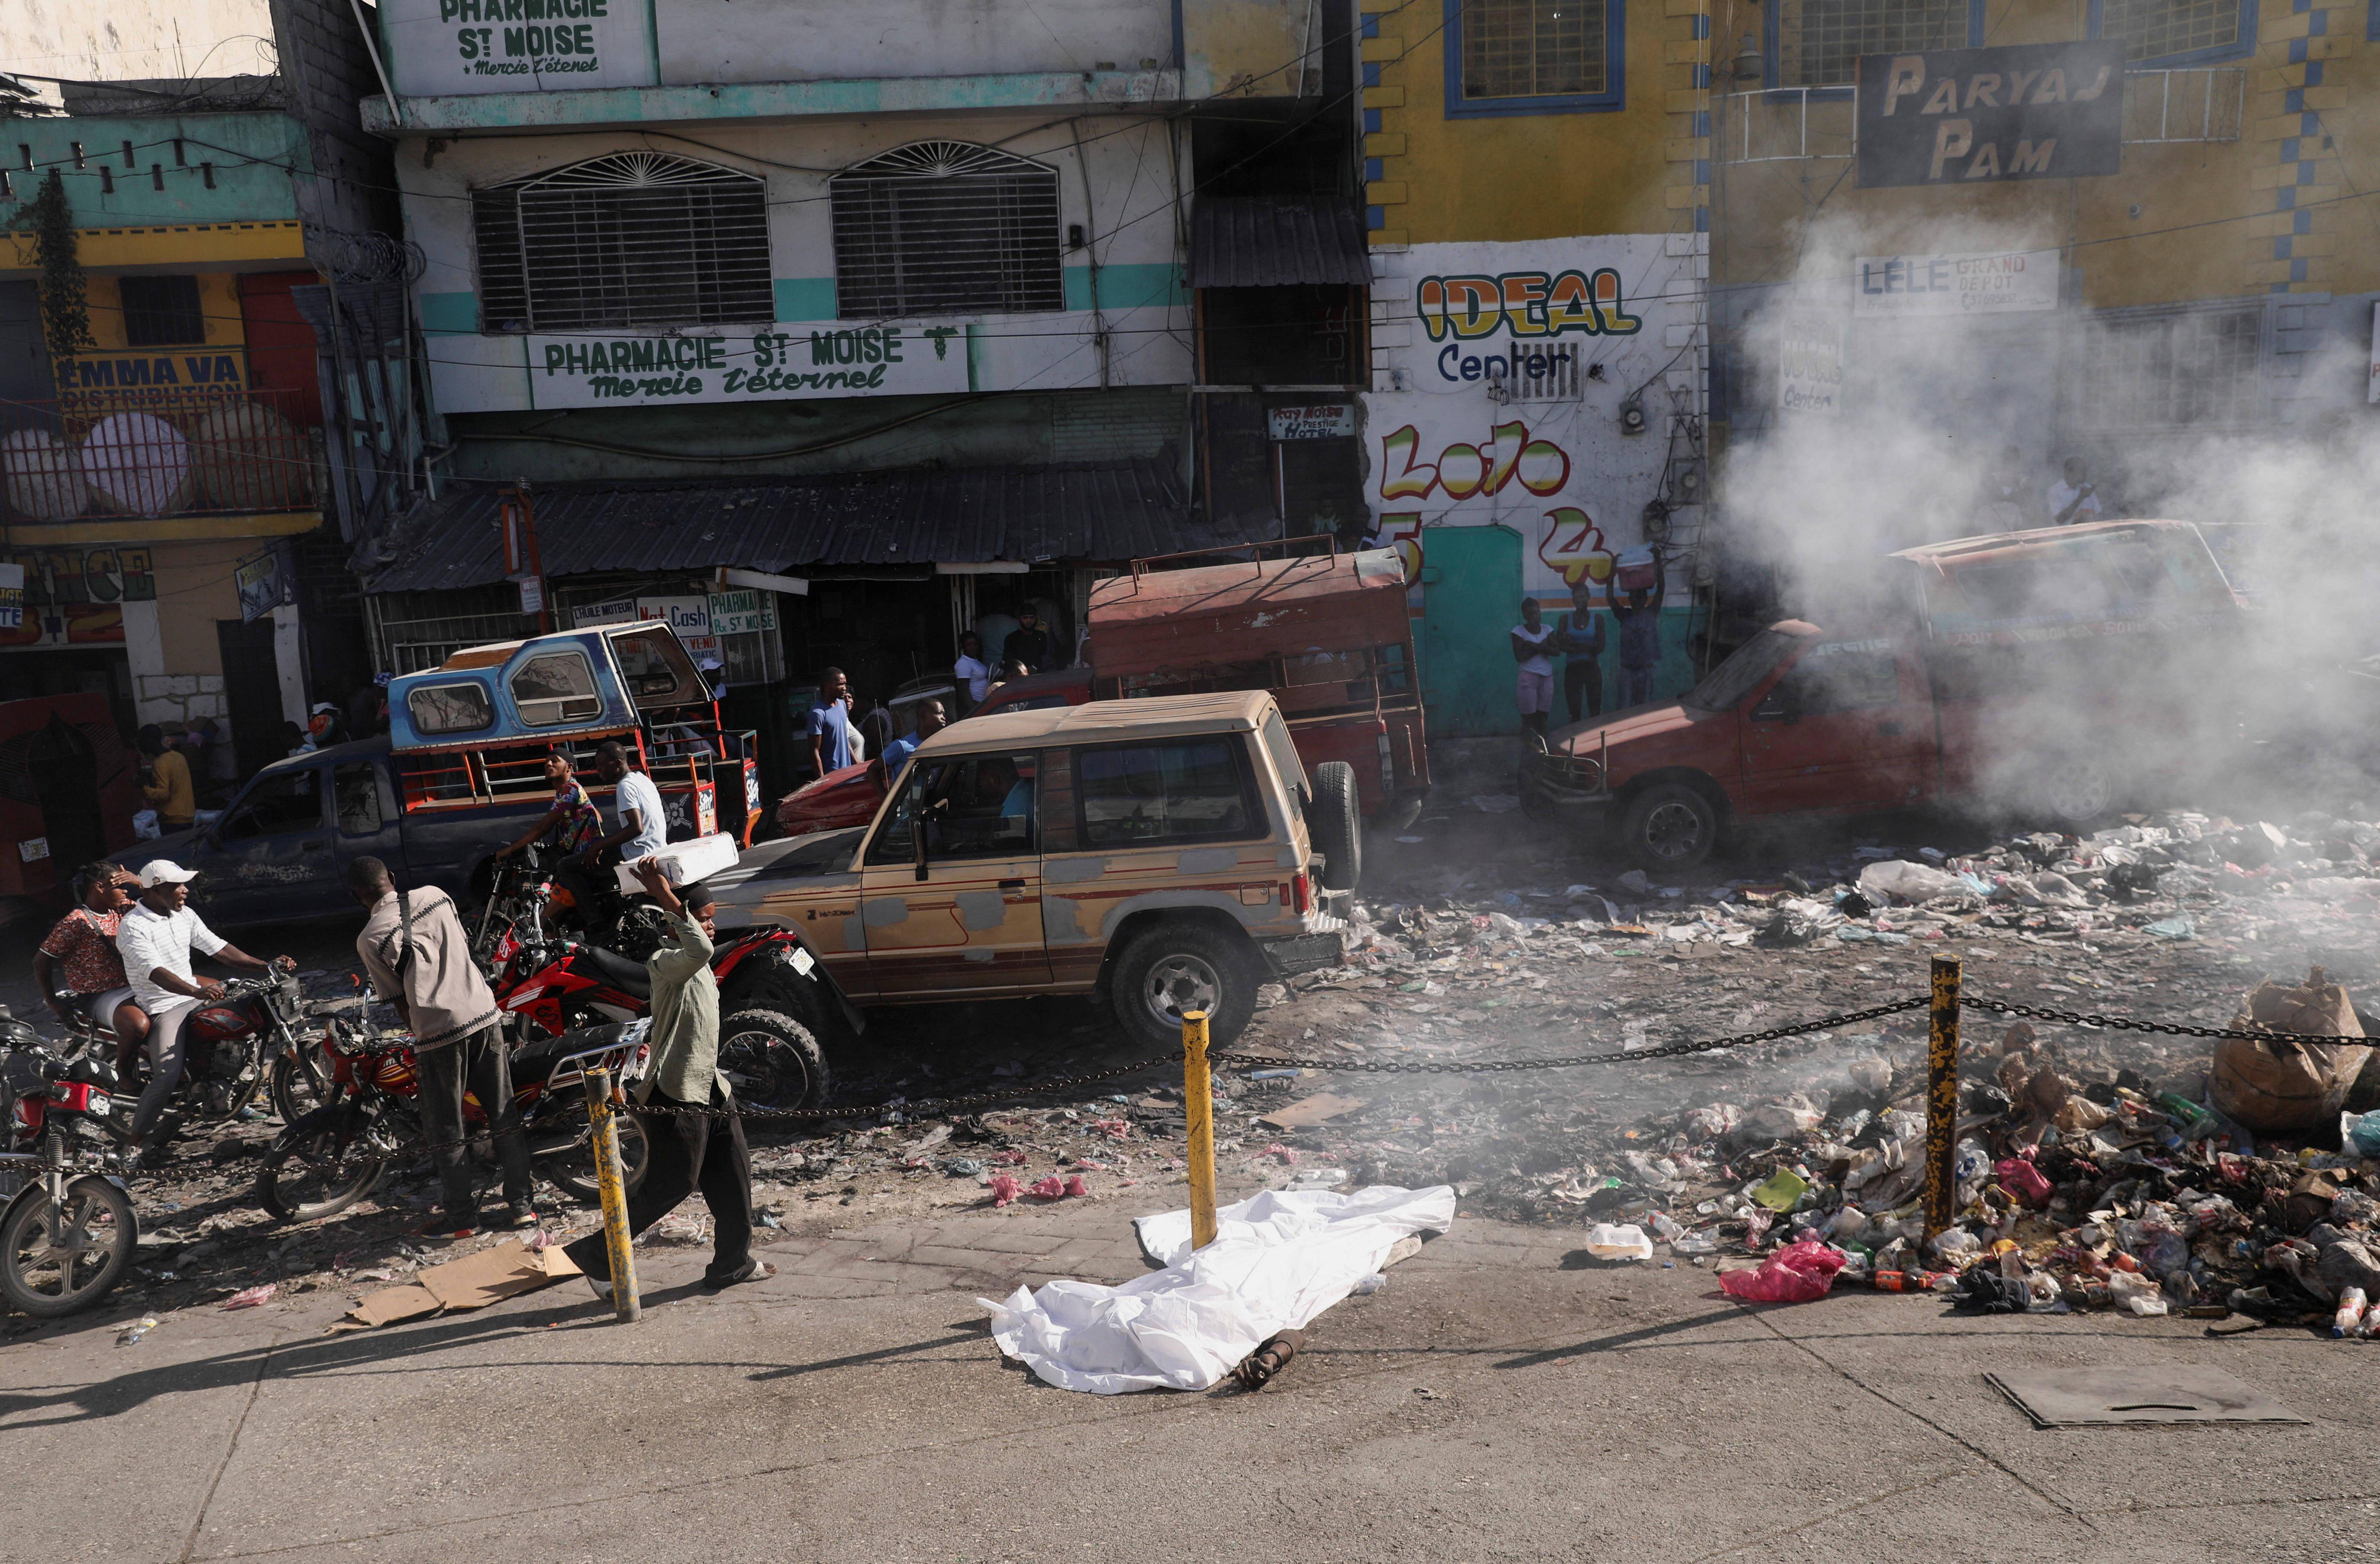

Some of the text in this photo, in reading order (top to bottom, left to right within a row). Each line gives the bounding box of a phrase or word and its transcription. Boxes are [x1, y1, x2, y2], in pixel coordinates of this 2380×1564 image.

[504, 24, 595, 57] MOISE
[1883, 55, 2112, 116] PARYAJ
[1929, 119, 2058, 179] PAM
[1956, 256, 2026, 275] GRAND
[1417, 267, 1643, 343] IDEAL
[545, 336, 727, 376] PHARMACIE
[811, 328, 904, 366] MOISE
[1438, 340, 1571, 382] Center
[61, 356, 240, 389] EMMA VA
[63, 384, 243, 408] DISTRIBUTION
[1784, 383, 1832, 411] Center
[1538, 507, 1615, 589] 4
[601, 602, 634, 616] MOTEUR
[671, 604, 706, 627] Cash
[711, 591, 771, 615] PHARMAIE
[746, 613, 774, 630] MOSE
[689, 636, 717, 650] VEND
[690, 650, 717, 659] RIATIC
